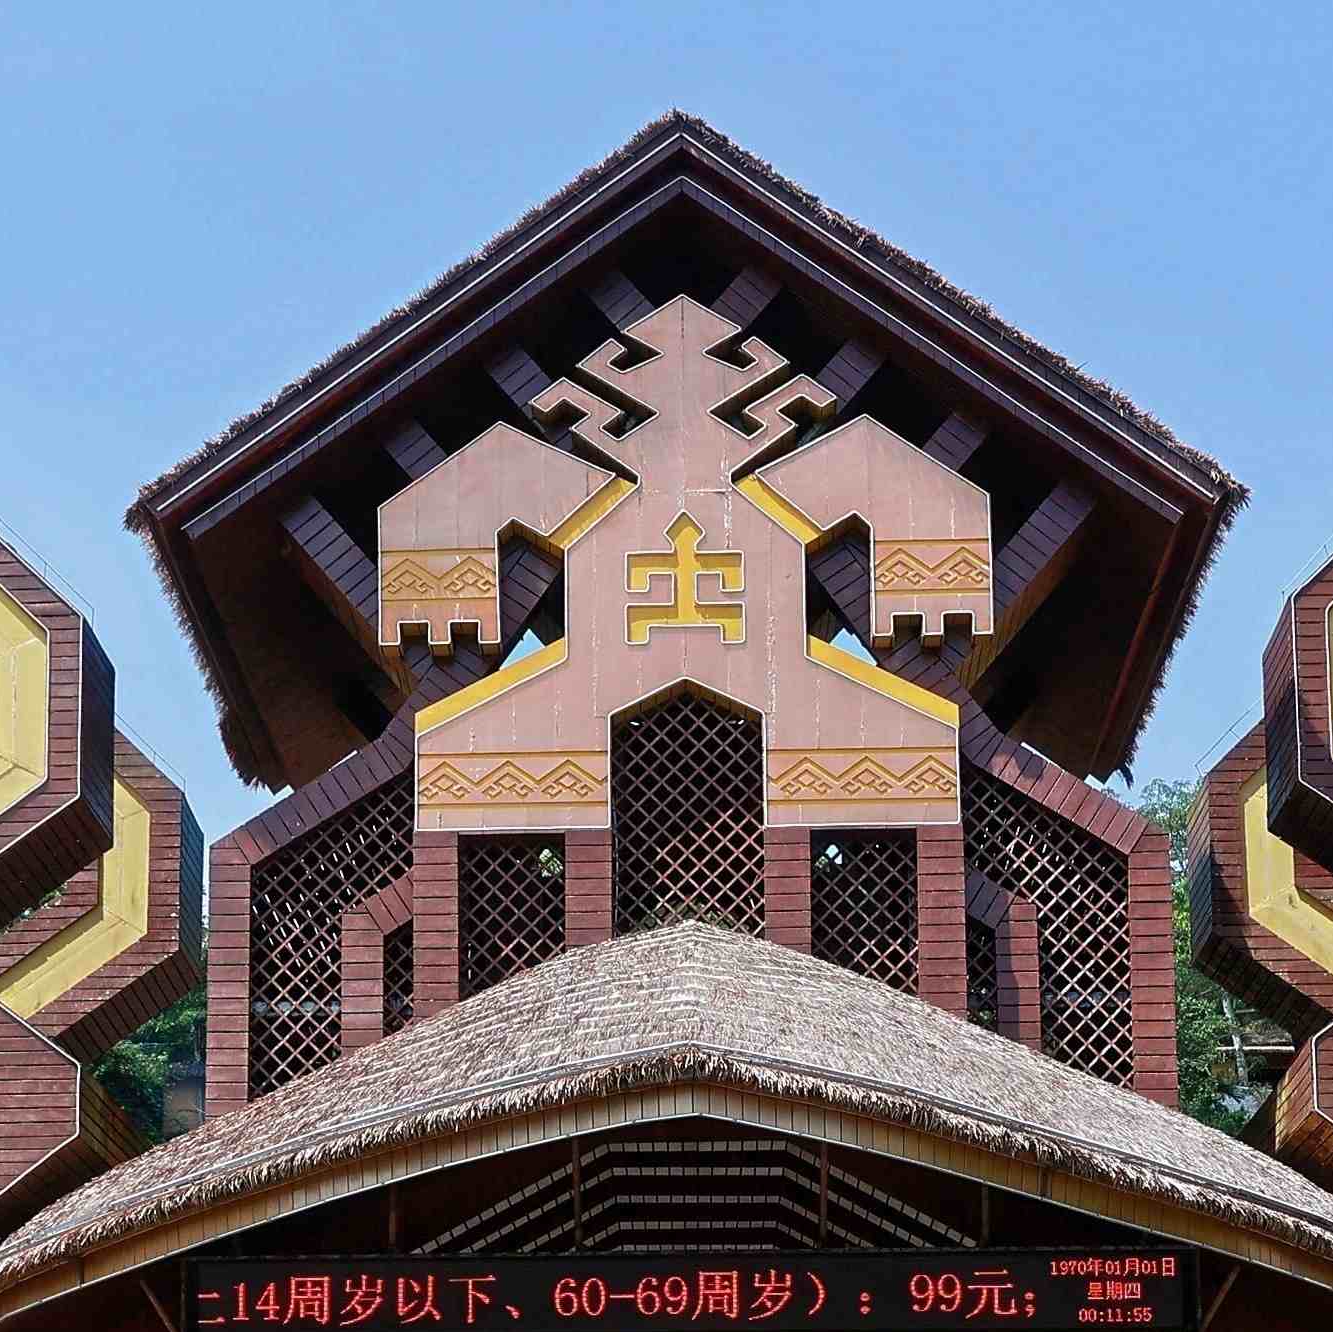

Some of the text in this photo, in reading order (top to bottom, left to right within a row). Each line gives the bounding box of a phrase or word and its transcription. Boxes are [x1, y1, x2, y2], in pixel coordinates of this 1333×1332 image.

[1050, 1257, 1177, 1278] 1970年01月01日
[1087, 1281, 1142, 1301] 星期四
[1078, 1307, 1153, 1323] 00:11:55
